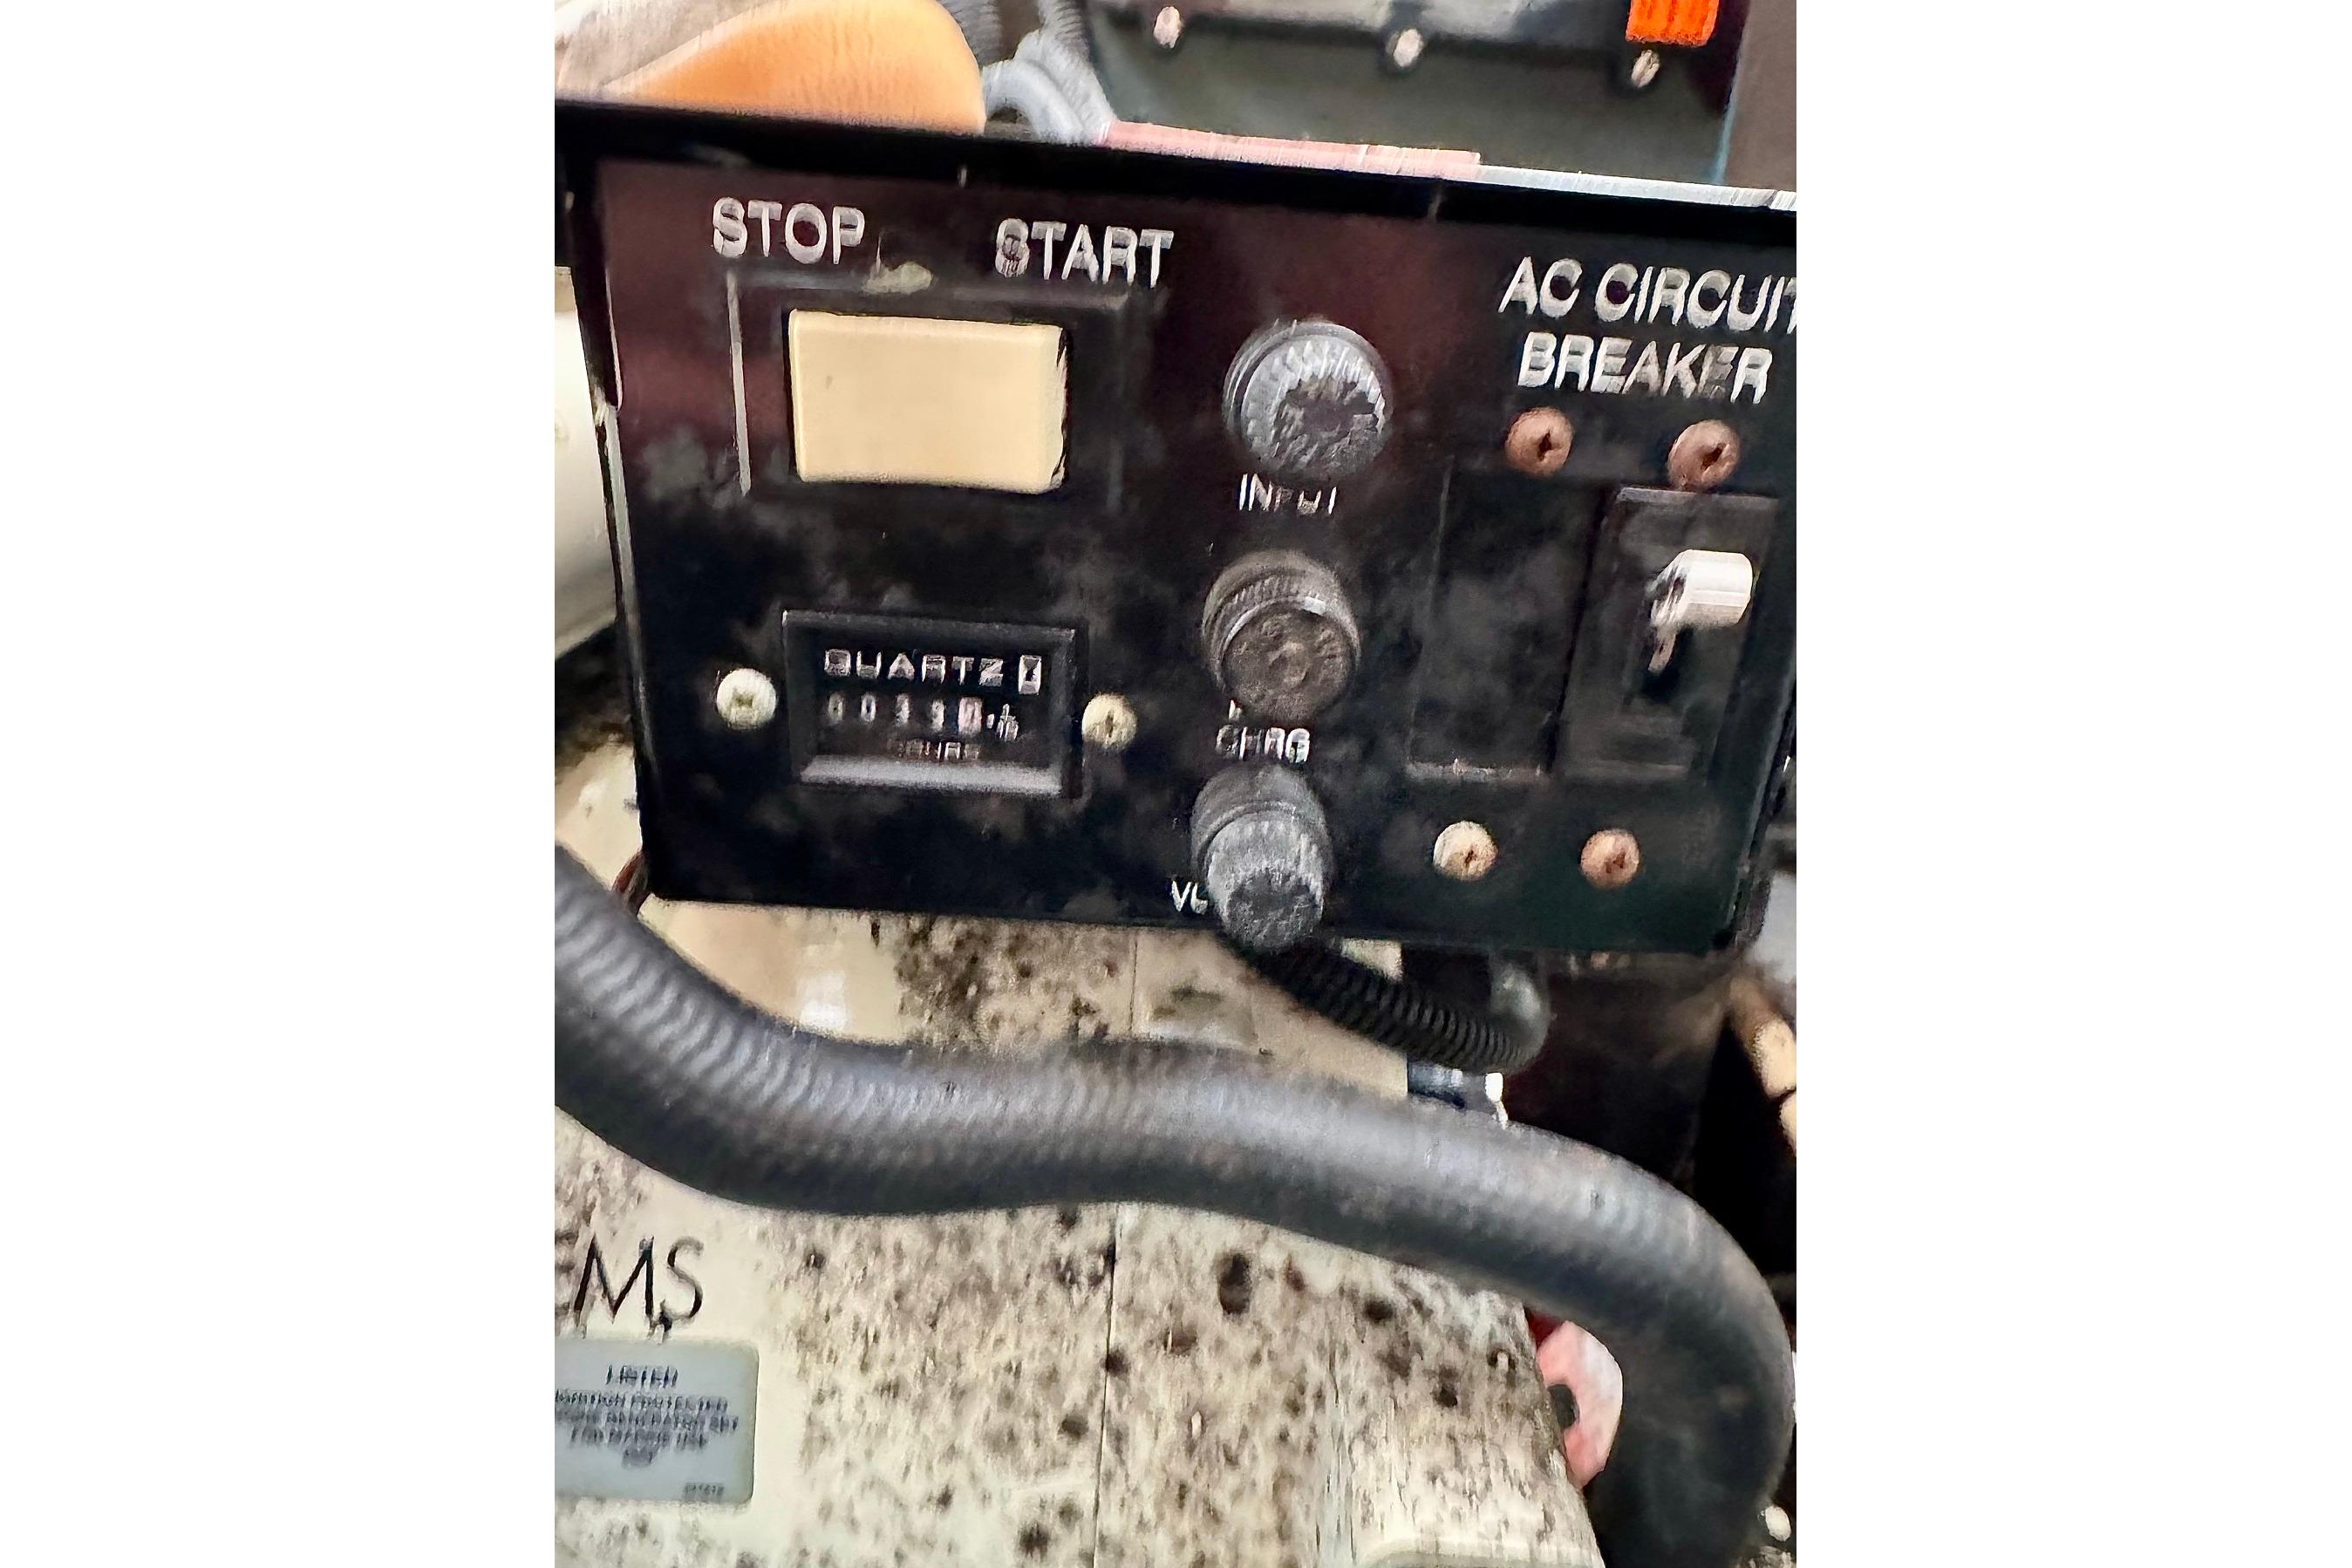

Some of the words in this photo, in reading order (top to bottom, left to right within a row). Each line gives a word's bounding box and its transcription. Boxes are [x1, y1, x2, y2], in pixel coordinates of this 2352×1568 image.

[712, 197, 866, 264] STOP
[994, 217, 1175, 288] START
[1497, 256, 1584, 319] AC
[1517, 331, 1773, 405] BREAKER
[1216, 724, 1311, 765] CHRG
